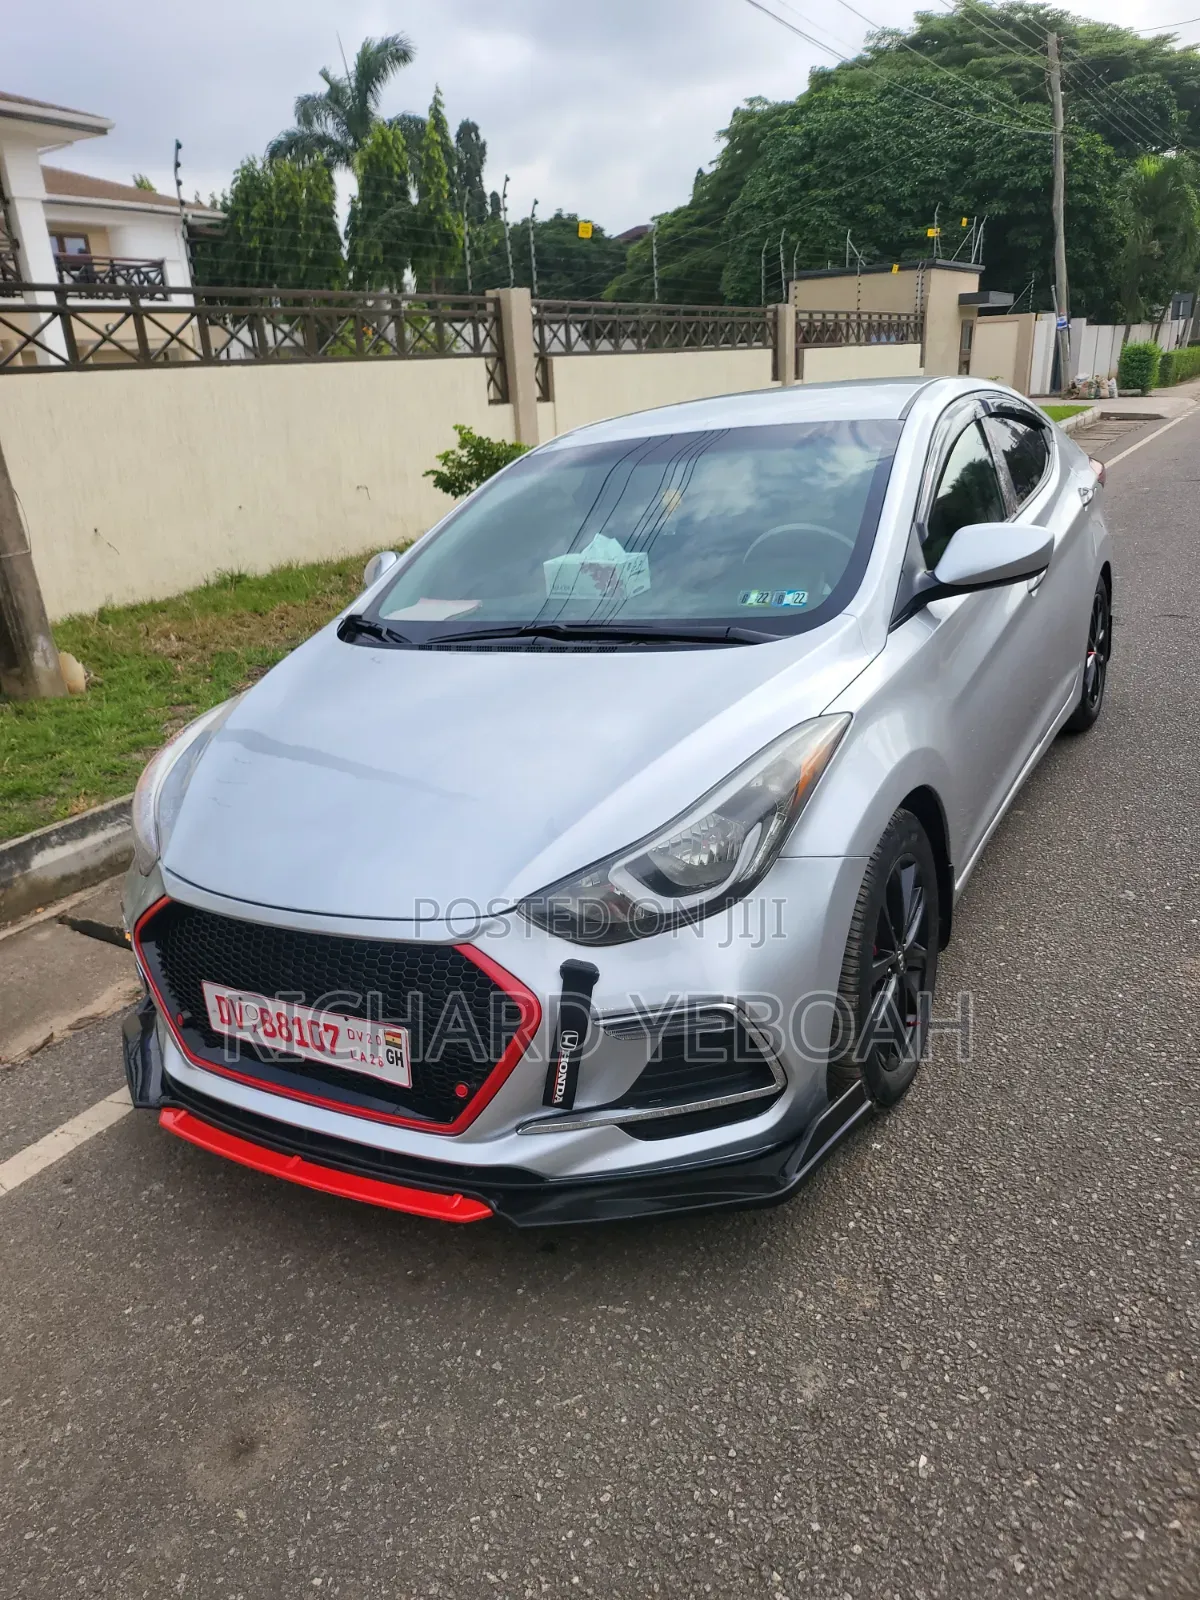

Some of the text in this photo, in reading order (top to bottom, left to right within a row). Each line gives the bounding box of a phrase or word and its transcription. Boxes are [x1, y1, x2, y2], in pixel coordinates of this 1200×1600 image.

[757, 592, 769, 604] 22
[794, 592, 806, 604] 22
[215, 994, 244, 1030] DV
[386, 1048, 404, 1068] GH
[553, 1050, 570, 1104] HONDA
